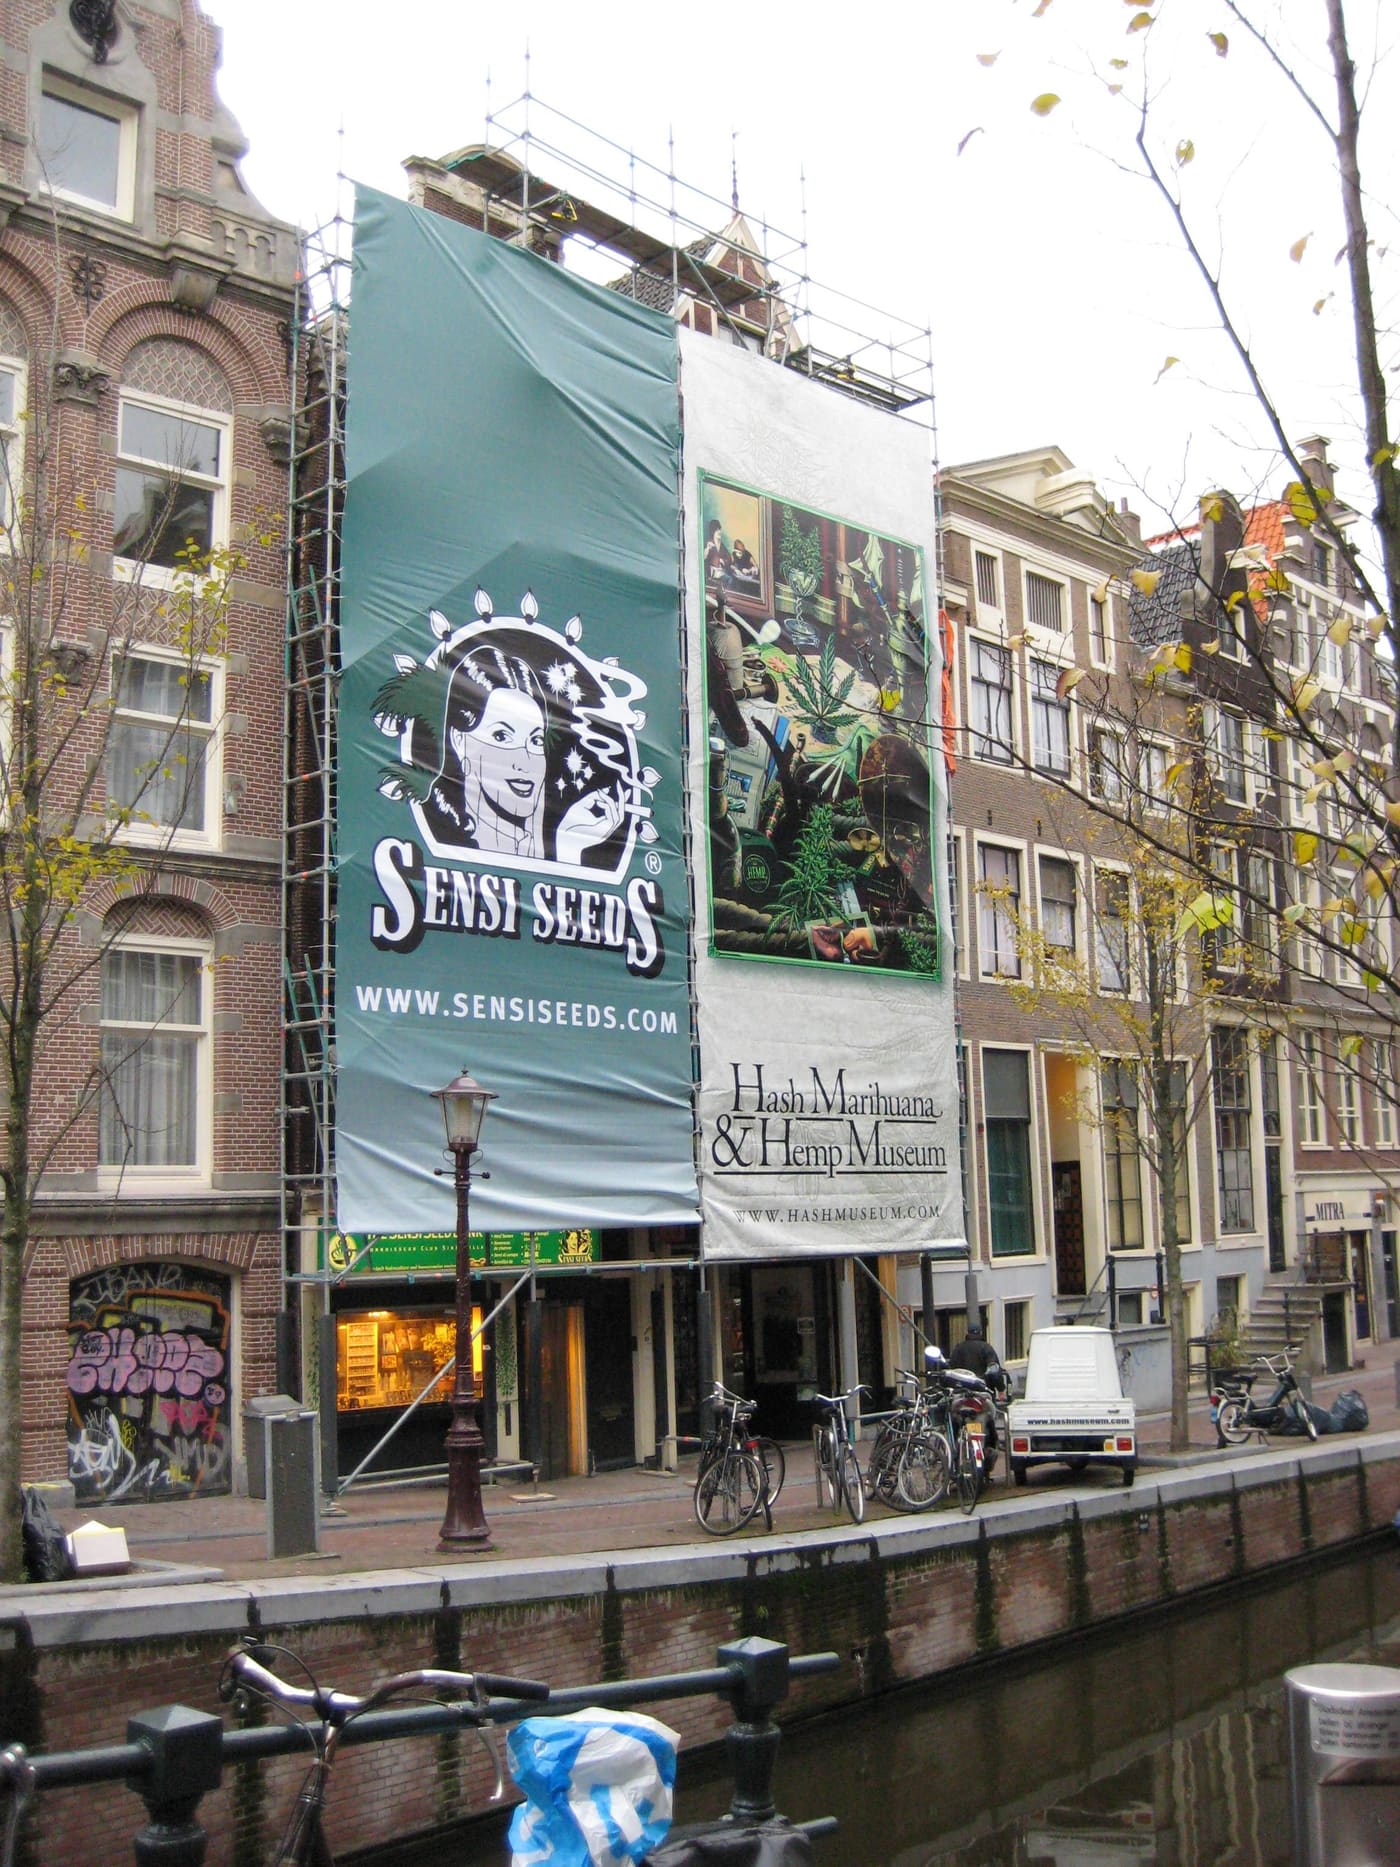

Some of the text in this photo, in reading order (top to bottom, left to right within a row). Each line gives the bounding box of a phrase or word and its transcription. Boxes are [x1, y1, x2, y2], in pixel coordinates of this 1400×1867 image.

[371, 838, 660, 971] SENSI SEEDS
[356, 985, 677, 1034] WWW.SENSISEEDS.COM
[730, 1062, 943, 1118] Hash Marihuana
[711, 1113, 947, 1178] & Hemp Museum
[734, 1205, 941, 1223] WWW.HASHMUSEUM.COM
[1316, 1202, 1344, 1220] MITRA
